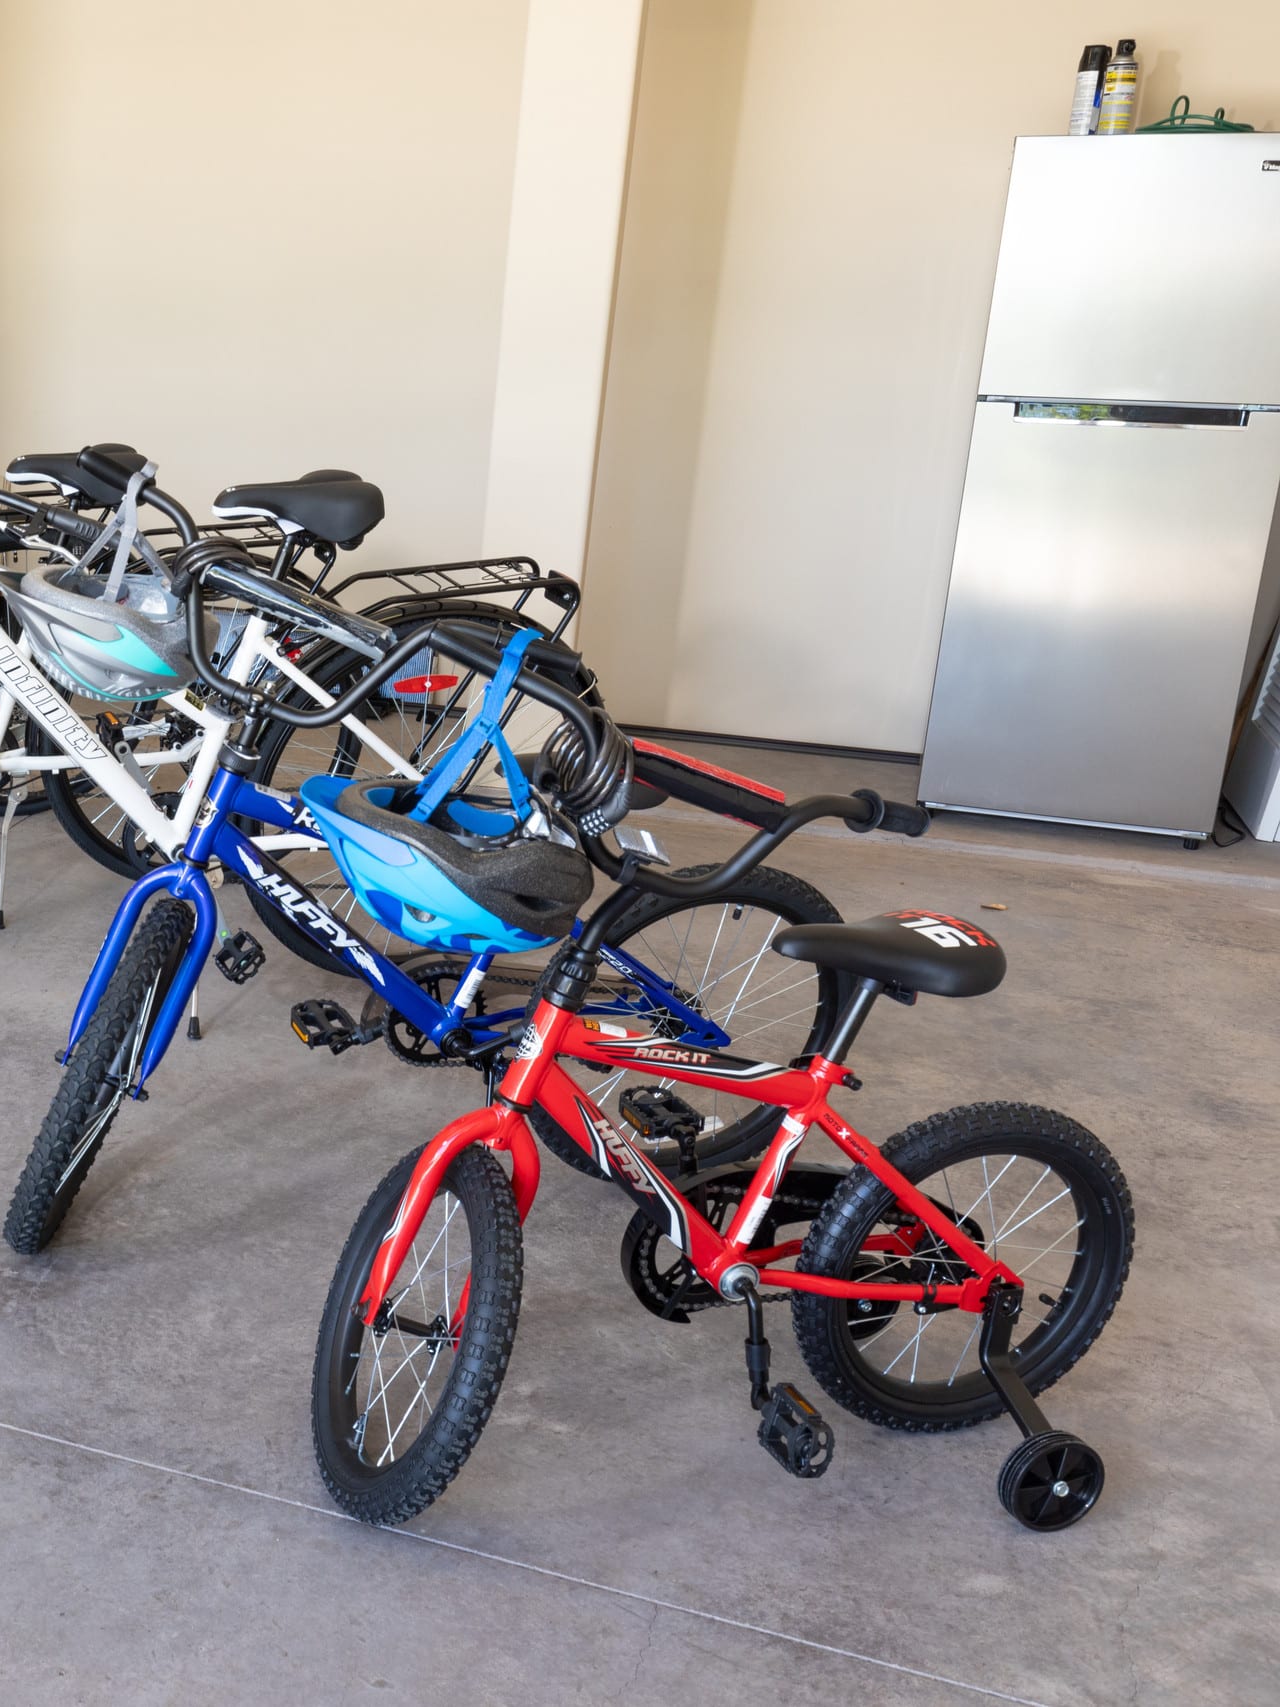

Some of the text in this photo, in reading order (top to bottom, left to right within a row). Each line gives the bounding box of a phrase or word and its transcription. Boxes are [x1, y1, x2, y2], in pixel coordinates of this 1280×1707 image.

[258, 872, 362, 949] HUFFY
[899, 916, 978, 949] 16
[633, 1047, 712, 1065] ROCK IT
[593, 1118, 658, 1195] HUFFY
